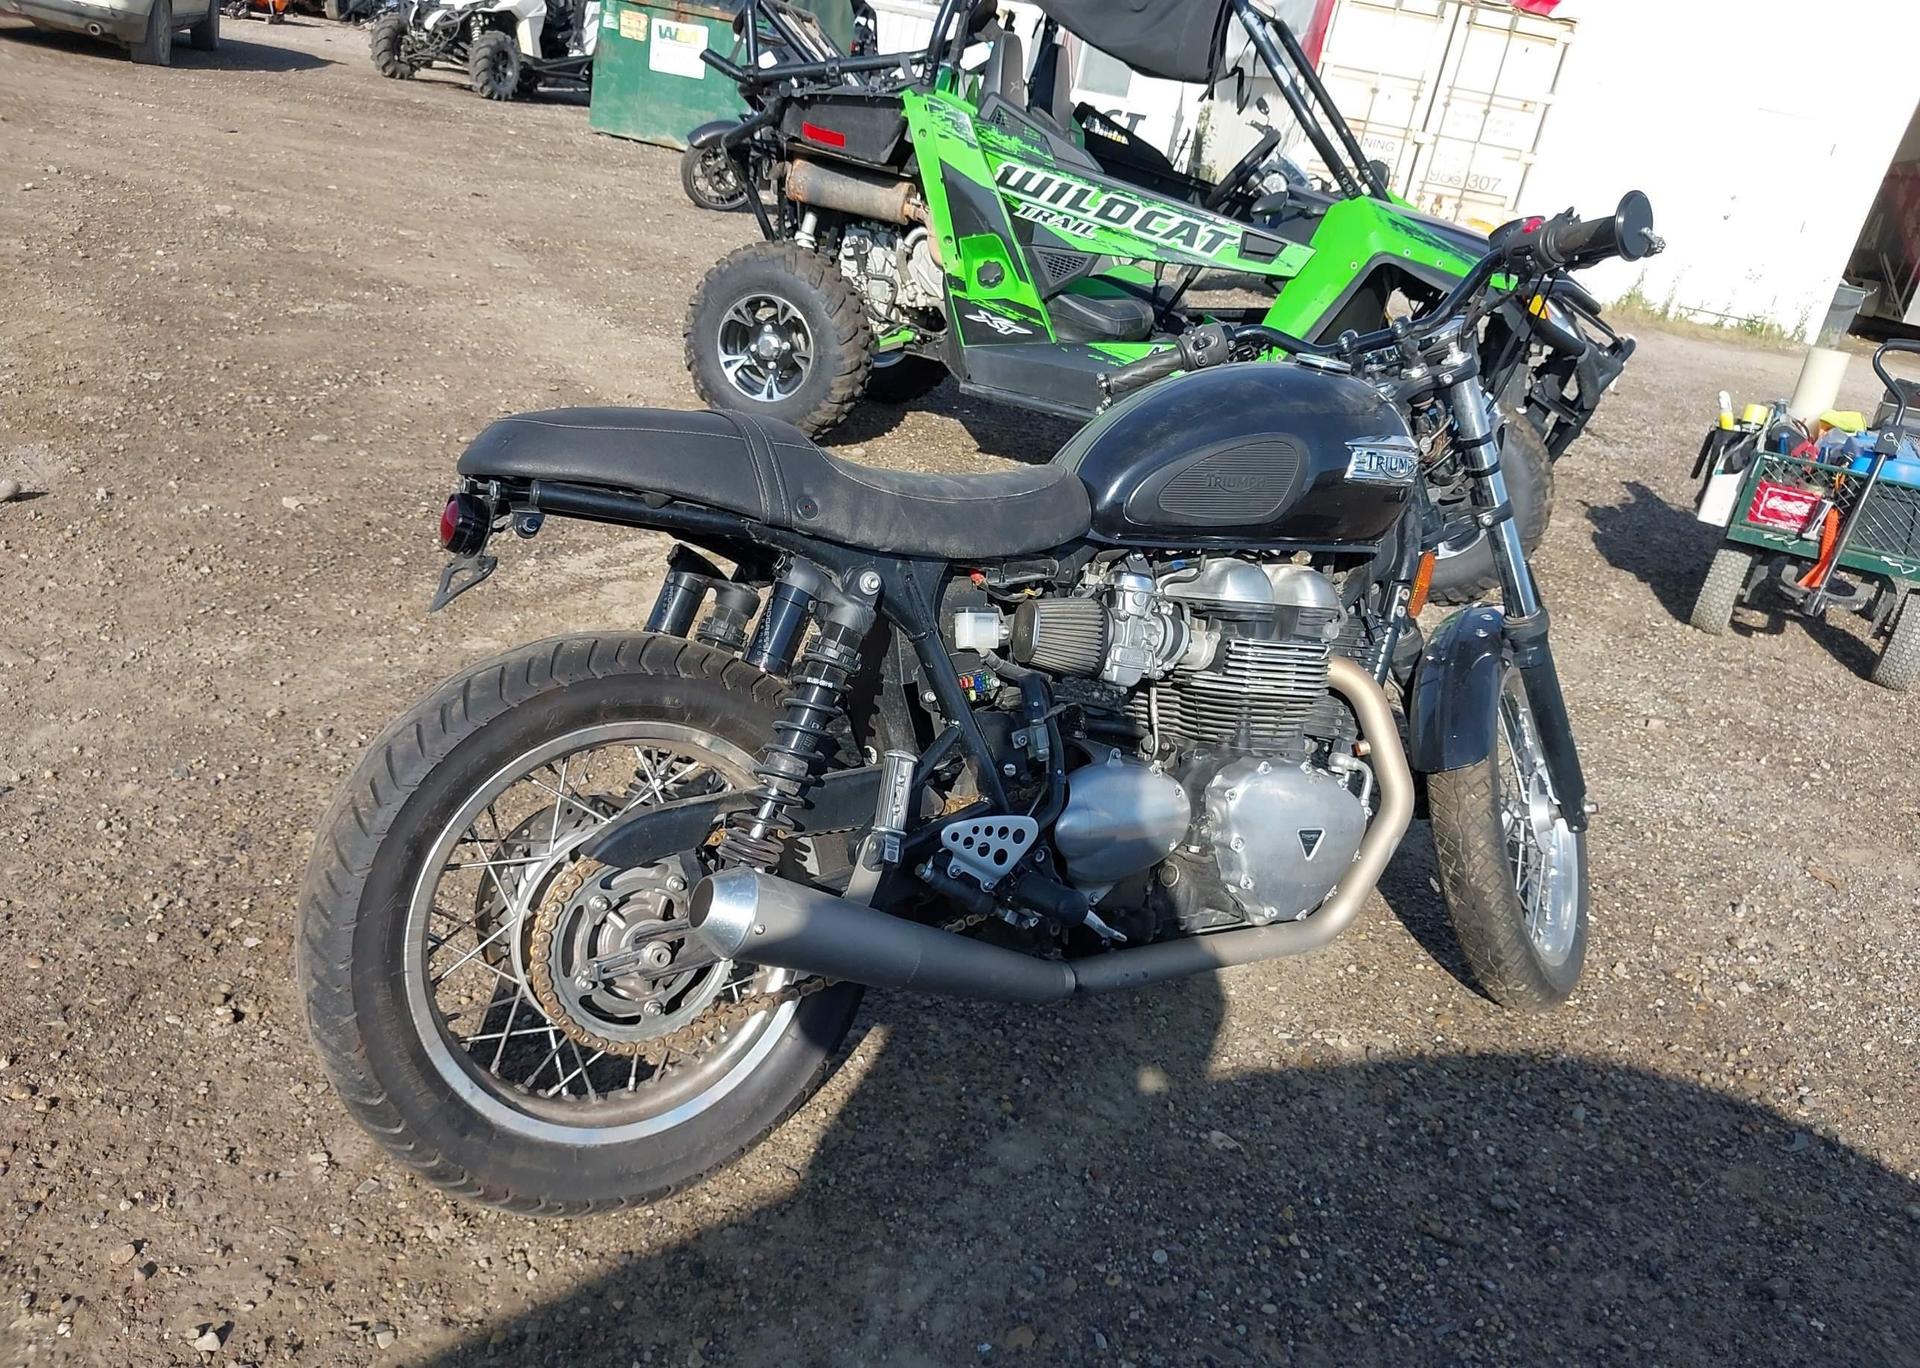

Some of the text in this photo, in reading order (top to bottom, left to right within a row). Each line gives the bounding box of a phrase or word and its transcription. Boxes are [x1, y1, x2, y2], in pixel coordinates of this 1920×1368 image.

[996, 164, 1241, 257] WILDCAT
[1014, 203, 1096, 239] TRAIL
[1366, 452, 1415, 479] TRIUMP
[1205, 472, 1266, 493] TRIUMPH
